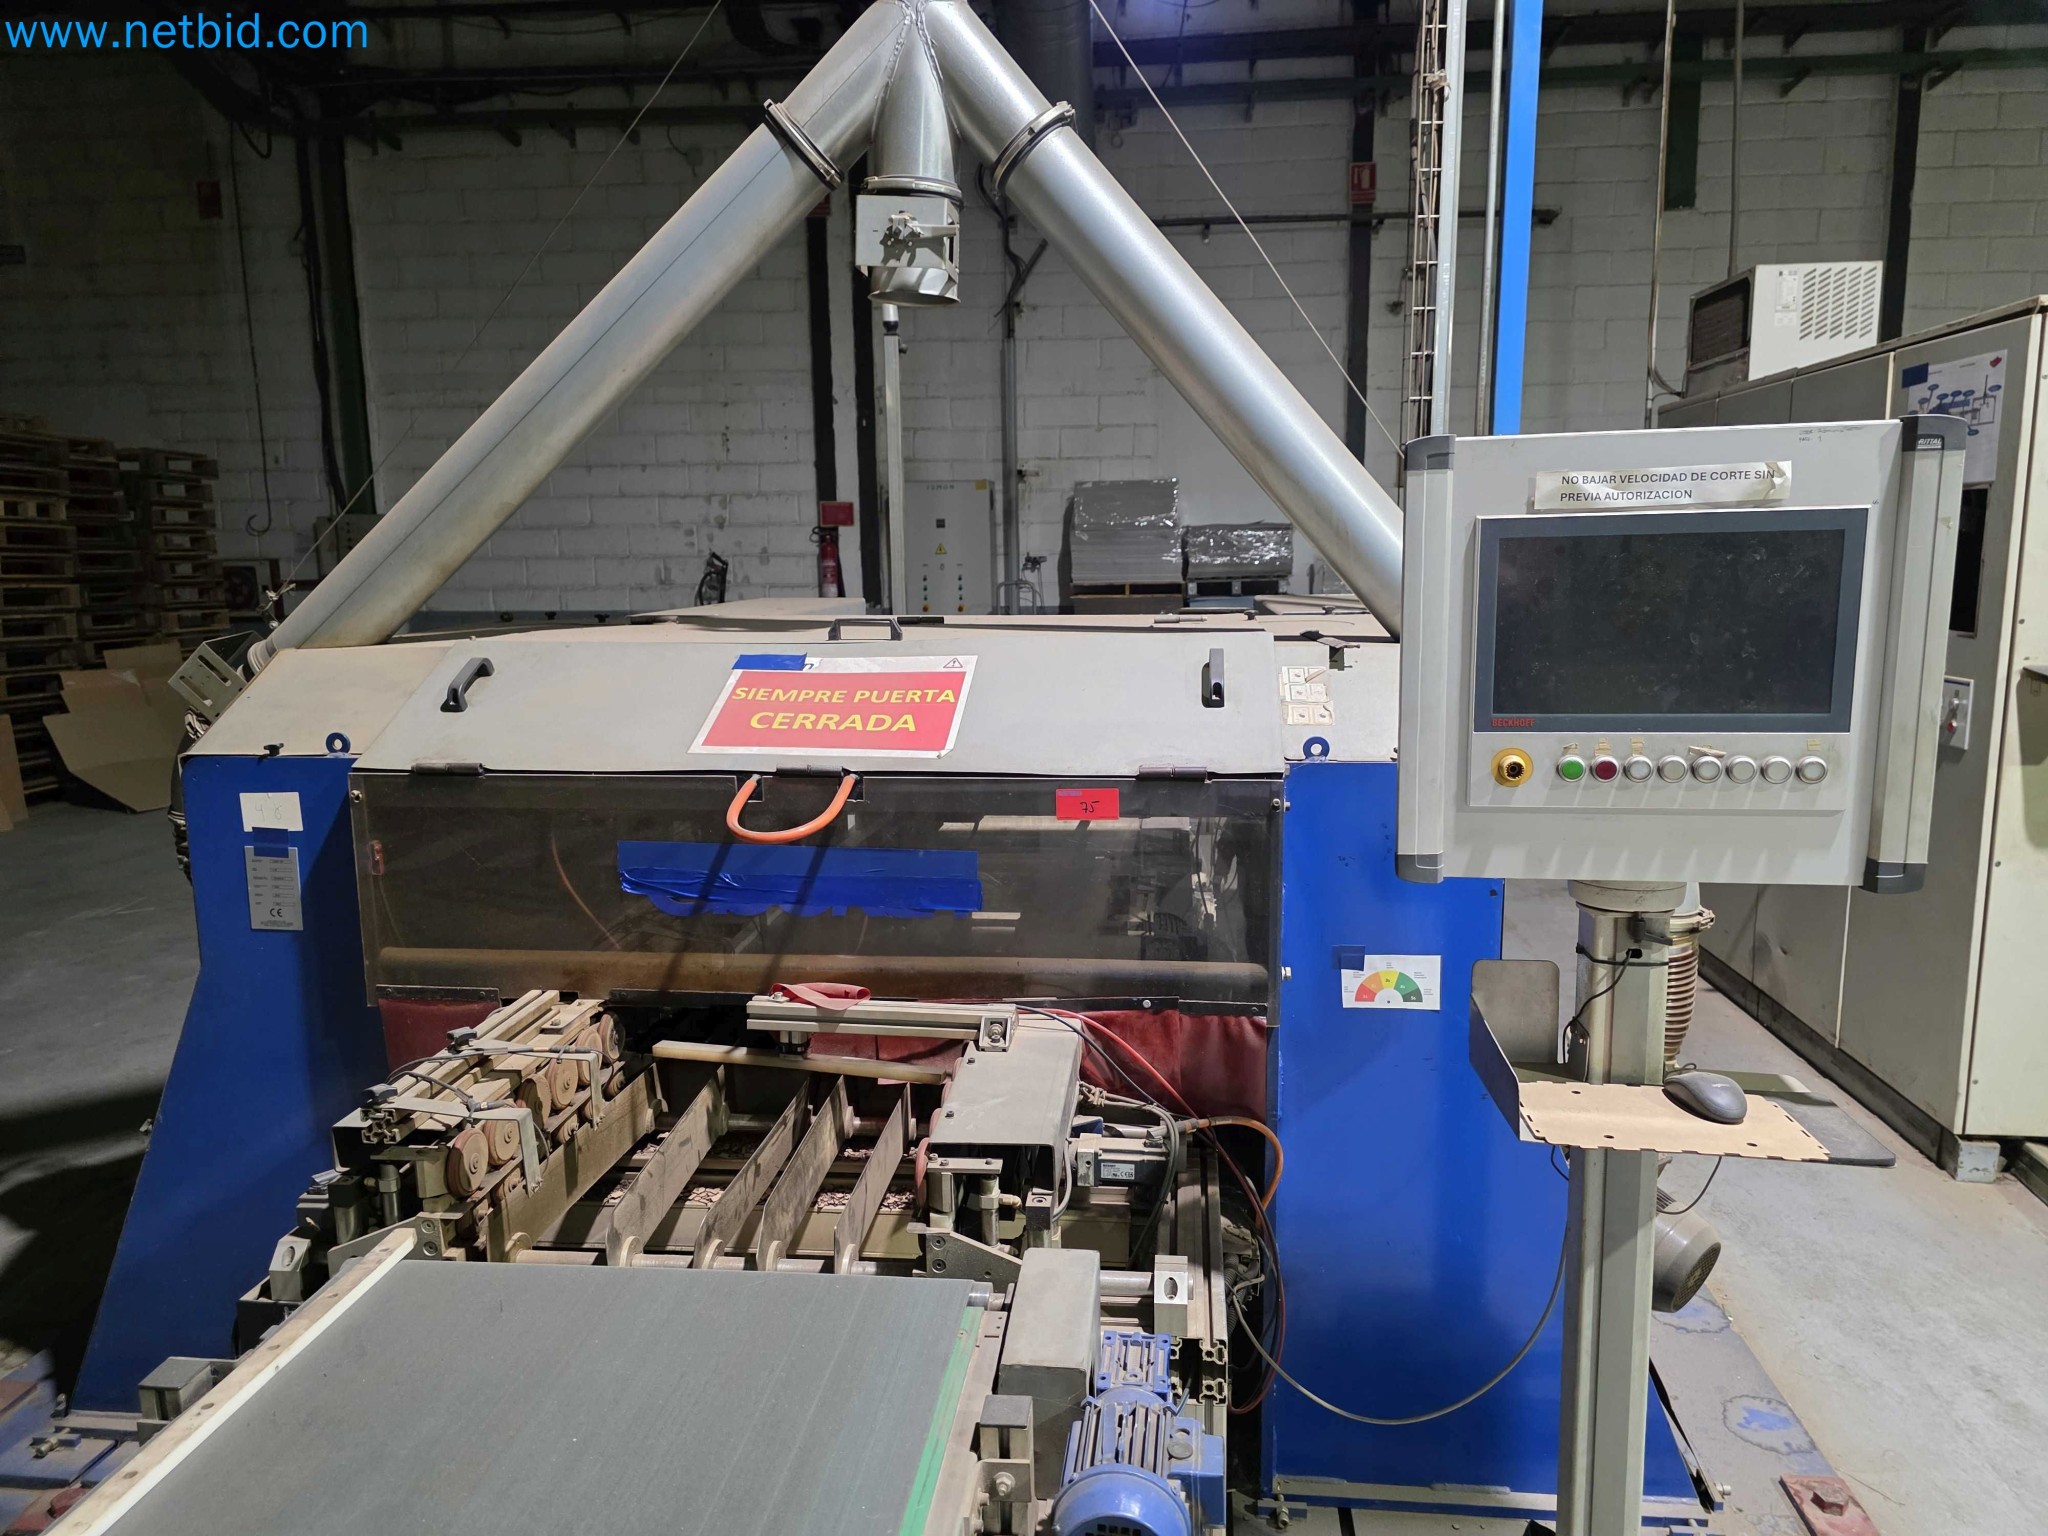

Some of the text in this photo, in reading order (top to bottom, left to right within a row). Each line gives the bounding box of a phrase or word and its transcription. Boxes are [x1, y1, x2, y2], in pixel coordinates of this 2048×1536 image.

[1561, 469, 1776, 485] NO BAJAR VELOCIDAD DE CORTE SIN
[1560, 489, 1693, 502] PREVIA AUTORIZACION
[731, 687, 956, 703] SIEMPRE PUERTA
[749, 711, 917, 732] CERRADA
[1491, 718, 1536, 727] BECKHOFF
[1080, 800, 1100, 813] 75
